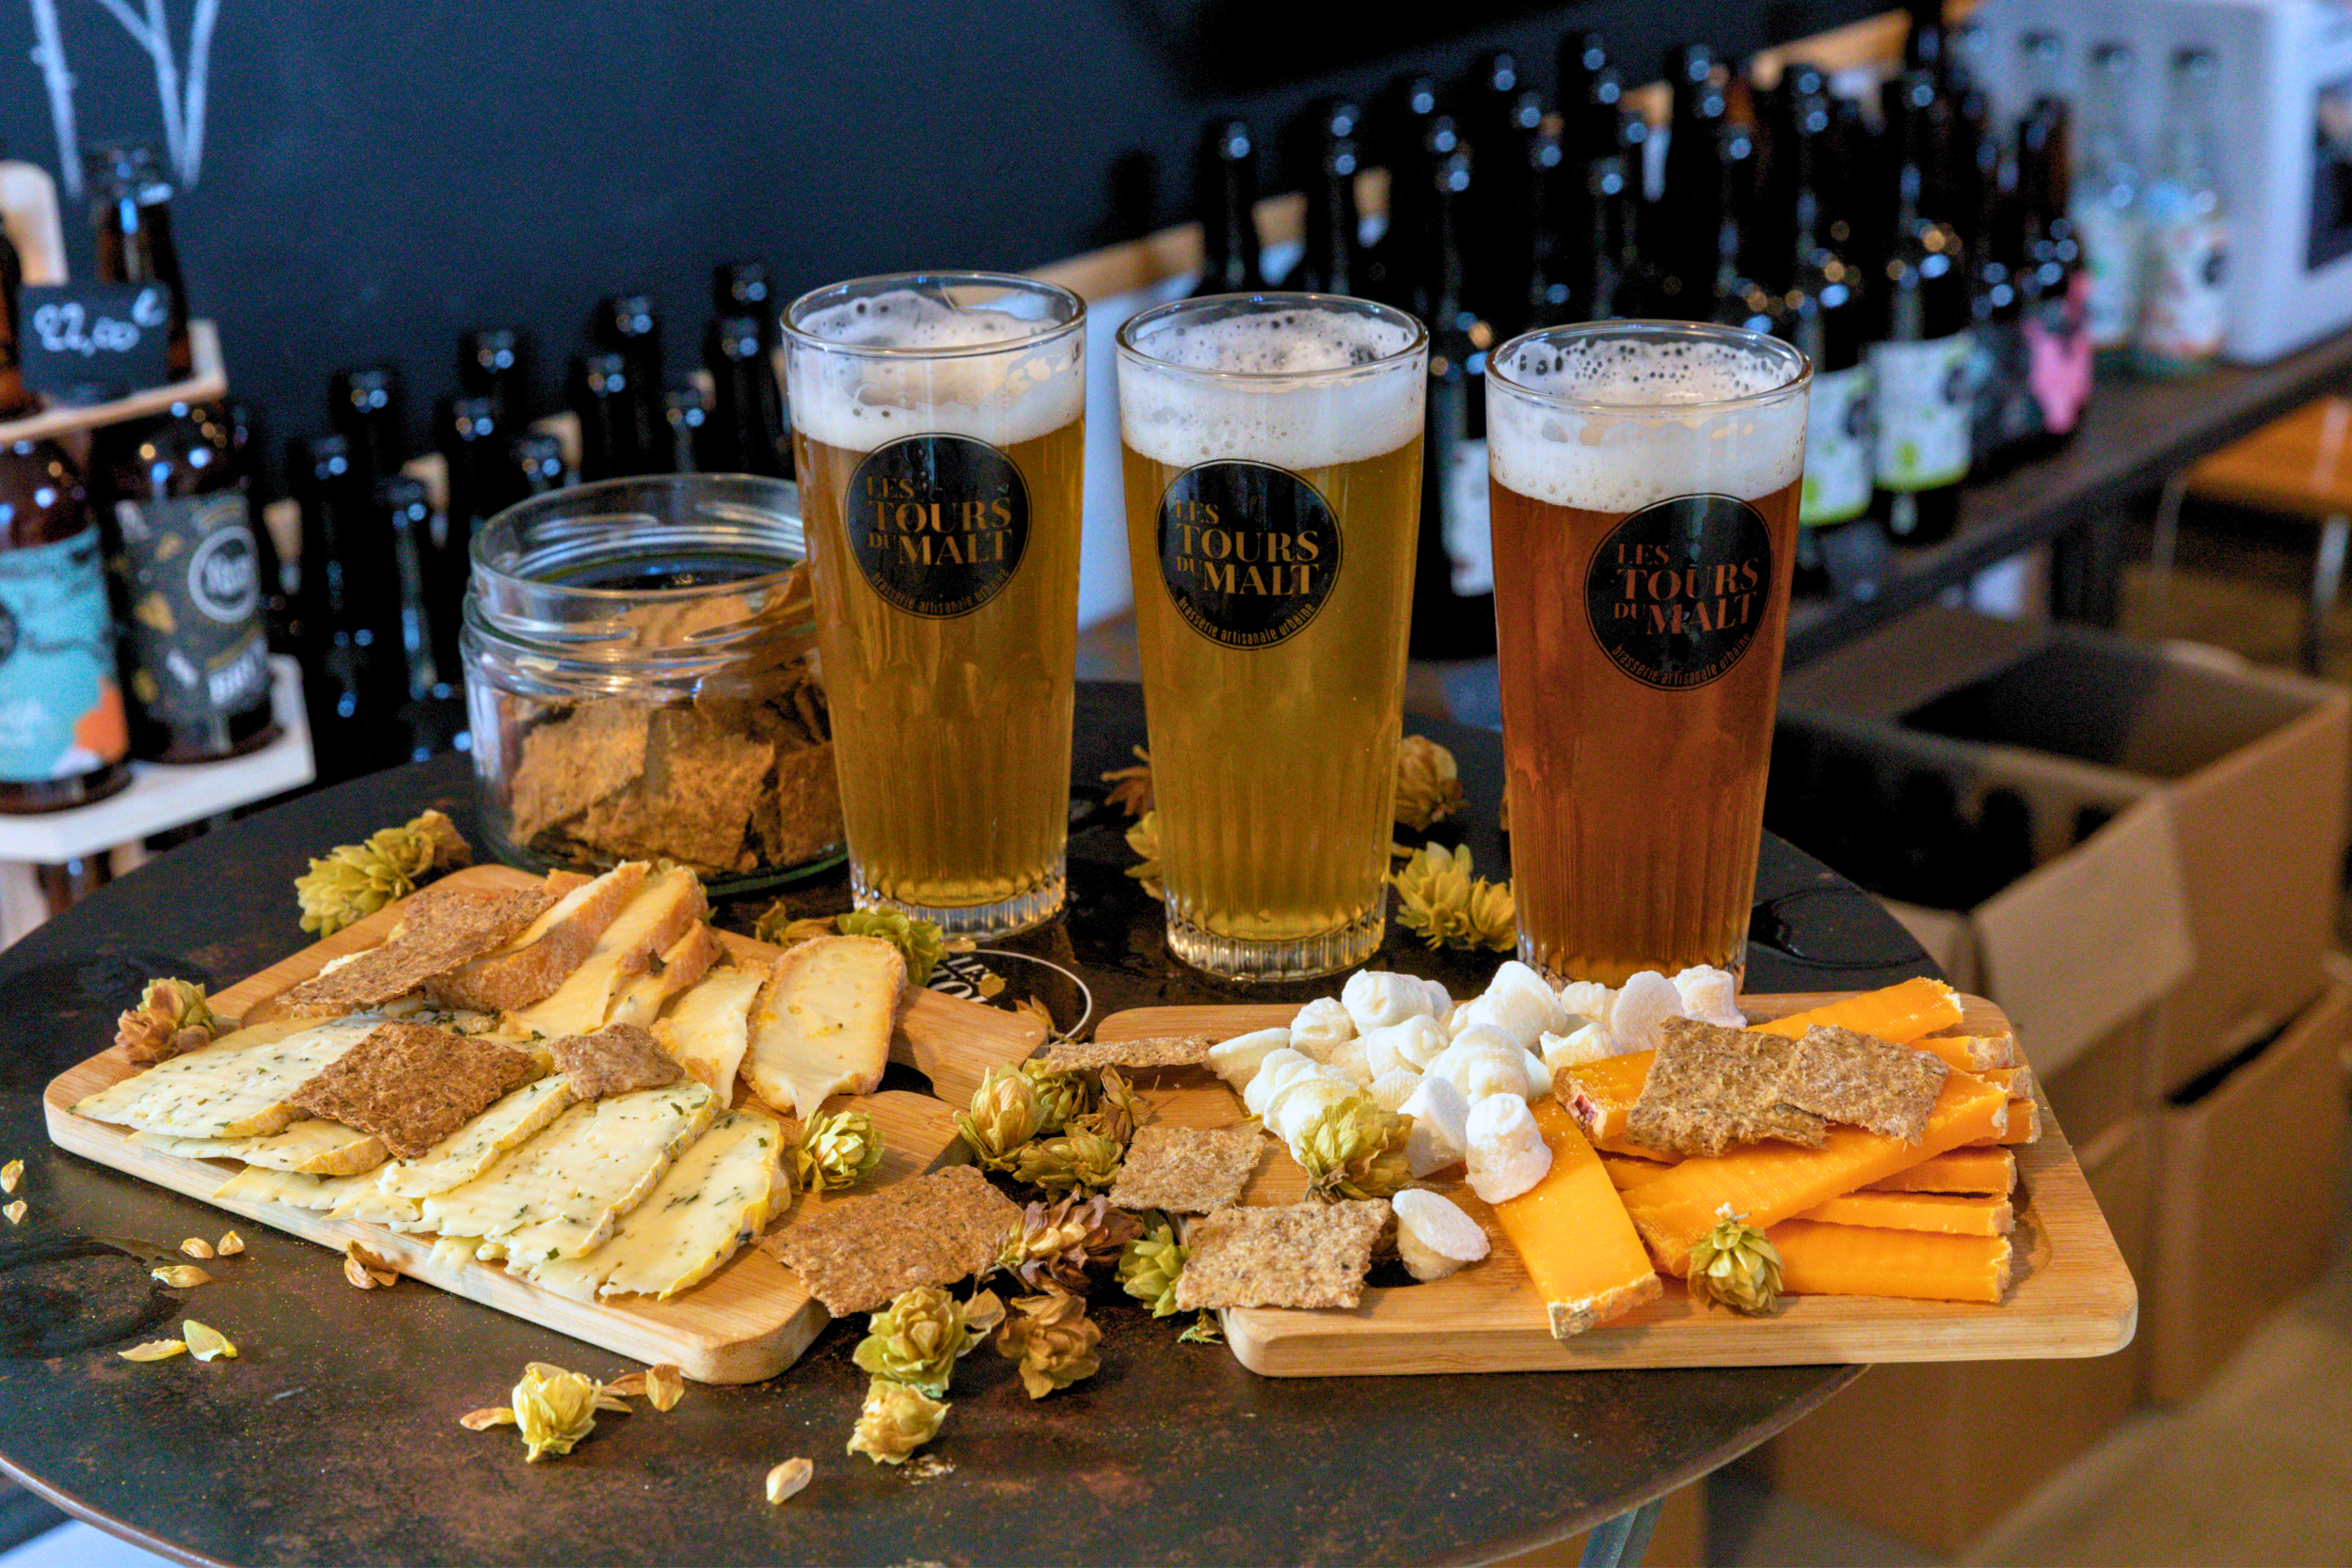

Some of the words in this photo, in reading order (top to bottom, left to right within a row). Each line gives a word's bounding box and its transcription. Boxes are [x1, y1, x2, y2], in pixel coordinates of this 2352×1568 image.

[866, 476, 914, 499] LES
[867, 498, 1012, 533] TOURS
[1176, 499, 1219, 525] LES
[899, 529, 1012, 565] MALT
[1176, 523, 1319, 562] TOURS
[1618, 543, 1670, 565] LES
[1177, 555, 1202, 575] DU
[1203, 561, 1319, 595] MALT
[1616, 558, 1759, 601] TOURS
[1178, 596, 1218, 637] brasserie
[1220, 627, 1279, 644] artisanale
[1279, 603, 1315, 635] urbaine
[1614, 603, 1646, 620] DU
[1646, 591, 1756, 635] MALT
[1612, 643, 1660, 682] brasserie
[1661, 664, 1718, 685] artisanale
[1719, 633, 1751, 670] urbaine
